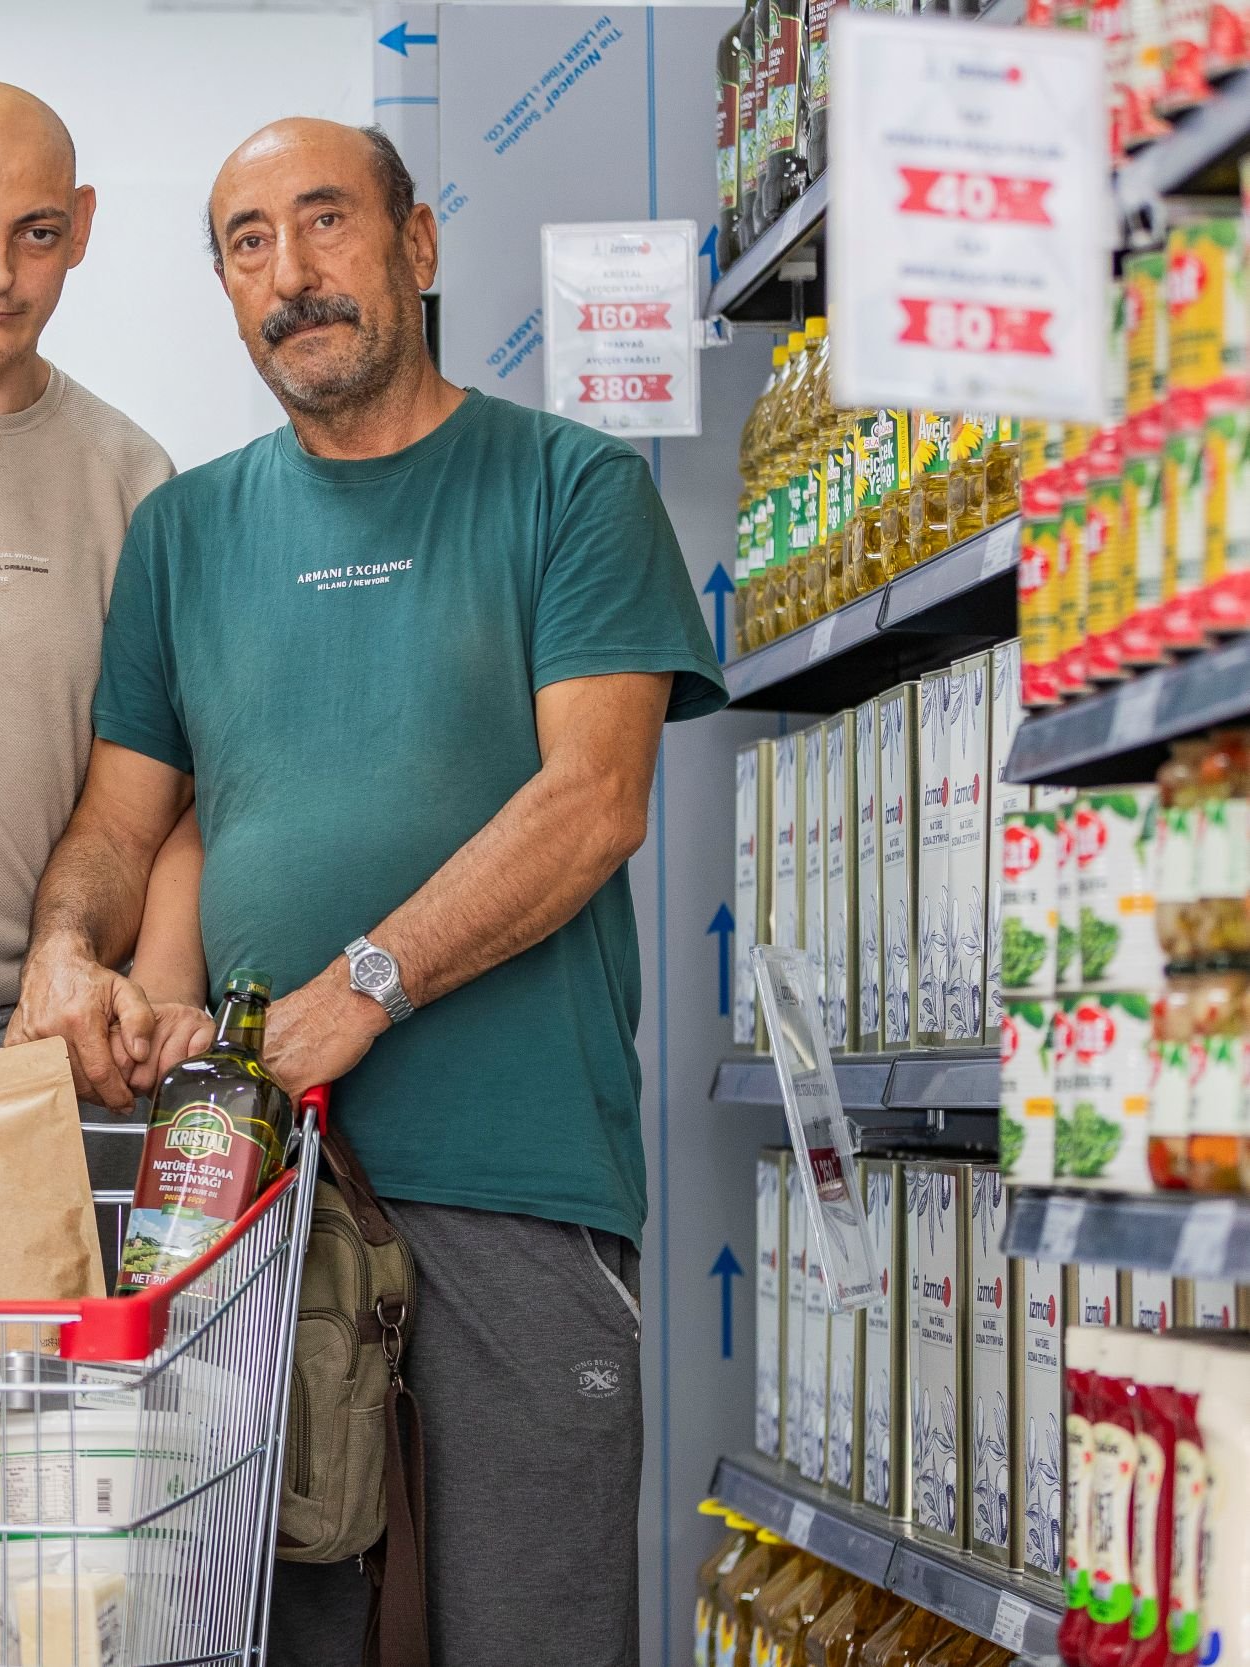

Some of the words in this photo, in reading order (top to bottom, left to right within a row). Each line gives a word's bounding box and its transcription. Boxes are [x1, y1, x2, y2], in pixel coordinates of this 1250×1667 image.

[595, 15, 611, 32] for
[564, 29, 598, 63] LASER
[599, 27, 623, 50] The
[540, 60, 567, 87] Fiber
[503, 92, 536, 126] LASER
[495, 109, 542, 155] Solution
[925, 173, 999, 217] 40
[589, 305, 638, 329] 160
[926, 305, 994, 341] 80
[505, 312, 542, 349] LASER
[497, 332, 544, 379] Solution
[589, 377, 643, 401] 380
[4, 564, 31, 572] DREAM
[297, 567, 342, 584] ARMANI
[346, 559, 414, 577] EXCHANGE
[317, 580, 347, 591] MILANO
[924, 783, 947, 807] izmar
[953, 781, 976, 806] izmar
[885, 802, 902, 825] izmar
[170, 1130, 225, 1153] KRISTAL
[153, 1160, 197, 1173] NATÜREL
[198, 1164, 233, 1180] SIZMA
[131, 1273, 152, 1284] NET
[922, 1274, 946, 1301] izmar
[976, 1278, 998, 1302] izmar
[1029, 1293, 1051, 1321] izmar
[1085, 1297, 1107, 1323] izmar
[1139, 1300, 1162, 1329] izmar
[928, 1315, 945, 1329] NATÜREL
[982, 1318, 996, 1331] NATÜREL
[1035, 1336, 1050, 1350] NATÜREL
[570, 1359, 593, 1374] LONG
[594, 1359, 621, 1371] BEACH
[578, 1375, 591, 1385] 19
[605, 1374, 618, 1383] 86
[577, 1388, 604, 1399] ORIGINAL
[604, 1386, 621, 1398] BRAND
